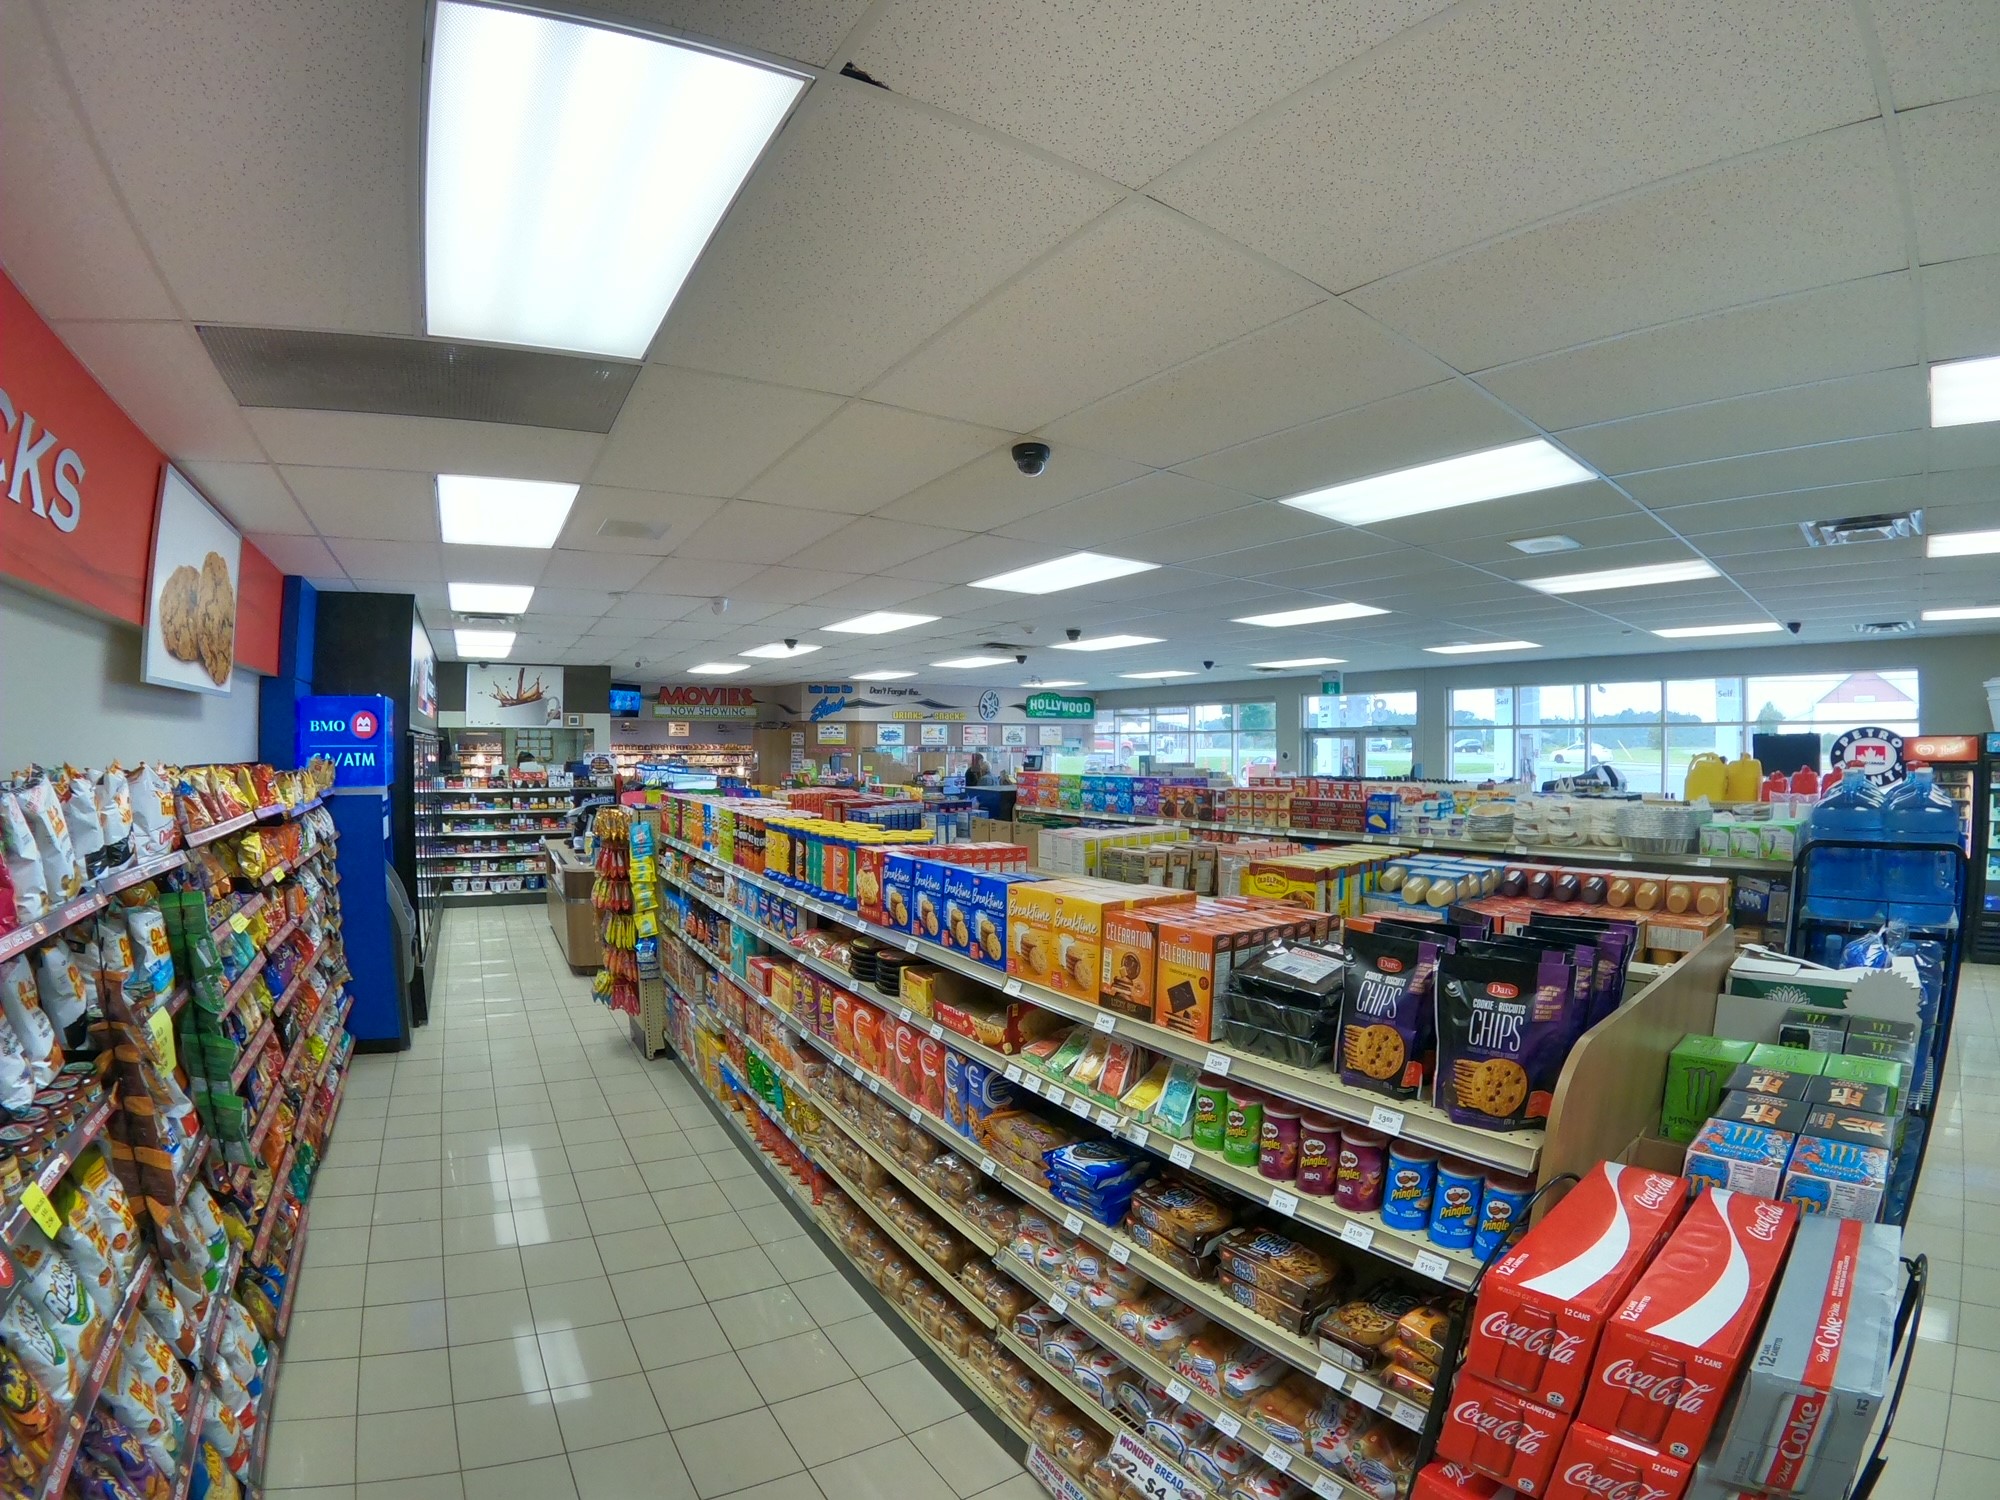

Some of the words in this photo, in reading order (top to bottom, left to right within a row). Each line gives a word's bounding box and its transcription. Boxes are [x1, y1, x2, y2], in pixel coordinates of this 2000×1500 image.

[657, 686, 753, 706] MOVIES
[869, 687, 886, 695] Don't
[887, 687, 908, 696] Forget
[670, 706, 695, 716] NOW
[699, 706, 747, 717] SHOWING
[1030, 699, 1091, 714] HOLLYWOOD
[310, 720, 346, 732] BMO
[1840, 728, 1902, 748] PETRO
[1008, 898, 1051, 922] Breaktime
[1054, 908, 1098, 934] Breaktime
[1381, 959, 1399, 970] Dare
[1491, 983, 1514, 996] Dare
[1356, 980, 1402, 1019] CHIPS
[1472, 998, 1495, 1009] COOKIE
[1498, 1003, 1527, 1015] BISCUITS
[1468, 1009, 1524, 1052] CHIPS
[1300, 1156, 1329, 1169] Pringles
[1304, 1172, 1321, 1181] BBQ
[1391, 1187, 1422, 1201] Pringles
[1633, 1173, 1676, 1210] Coca-Cola
[1440, 1204, 1473, 1219] Pringles
[1482, 1220, 1510, 1233] Pringle
[1745, 1200, 1785, 1241] Coca-Cola
[1496, 1264, 1514, 1277] 12
[1564, 1307, 1573, 1317] 12
[1573, 1310, 1591, 1323] CANS
[1620, 1309, 1639, 1322] 12
[1480, 1311, 1586, 1366] Coca-Cola
[1815, 1315, 1844, 1349] Coke
[1694, 1355, 1704, 1364] 12
[1703, 1357, 1723, 1370] CANS
[1758, 1353, 1777, 1368] 12
[1816, 1348, 1831, 1363] Diet
[1178, 1361, 1218, 1398] Wonder
[1602, 1358, 1717, 1414] Coca-Cola
[1518, 1398, 1527, 1408] 12
[1526, 1401, 1557, 1419] CANETTES
[1855, 1398, 1870, 1410] 12
[1453, 1400, 1550, 1456] Coca-Cola
[1780, 1401, 1820, 1461] Coke
[1118, 1434, 1155, 1470] WONDER
[1153, 1462, 1184, 1496] BREAD
[1125, 1462, 1138, 1480] 2
[1651, 1463, 1661, 1472] 12
[1660, 1465, 1679, 1478] CANS
[1034, 1448, 1065, 1485] WONDER
[1064, 1481, 1086, 1500] BREA
